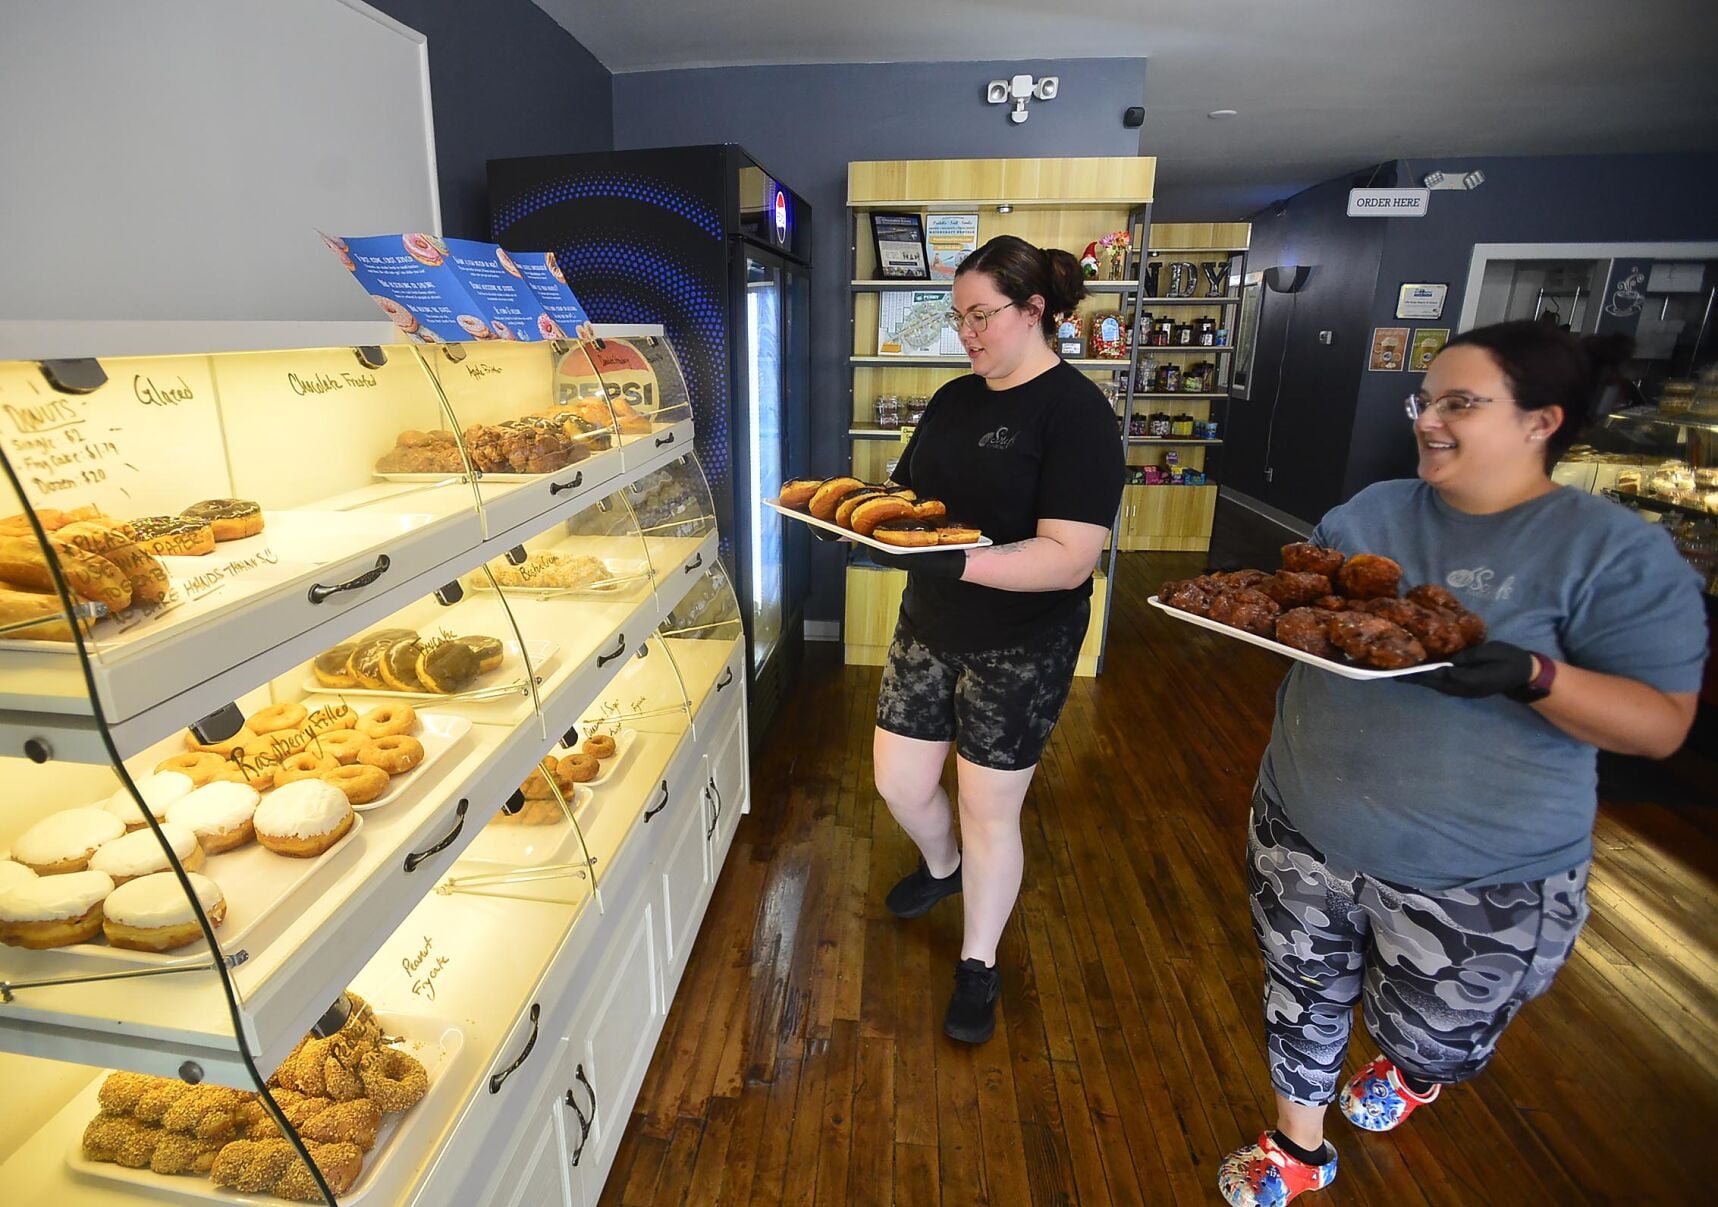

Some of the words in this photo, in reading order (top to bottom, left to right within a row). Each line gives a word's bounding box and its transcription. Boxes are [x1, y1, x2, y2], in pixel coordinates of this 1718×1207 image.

[1356, 197, 1391, 208] ORDER
[1393, 197, 1421, 207] HERE
[560, 381, 653, 406] PEPSI
[80, 468, 107, 485] $20
[230, 724, 324, 782] Raspberry
[307, 693, 349, 730] Filled
